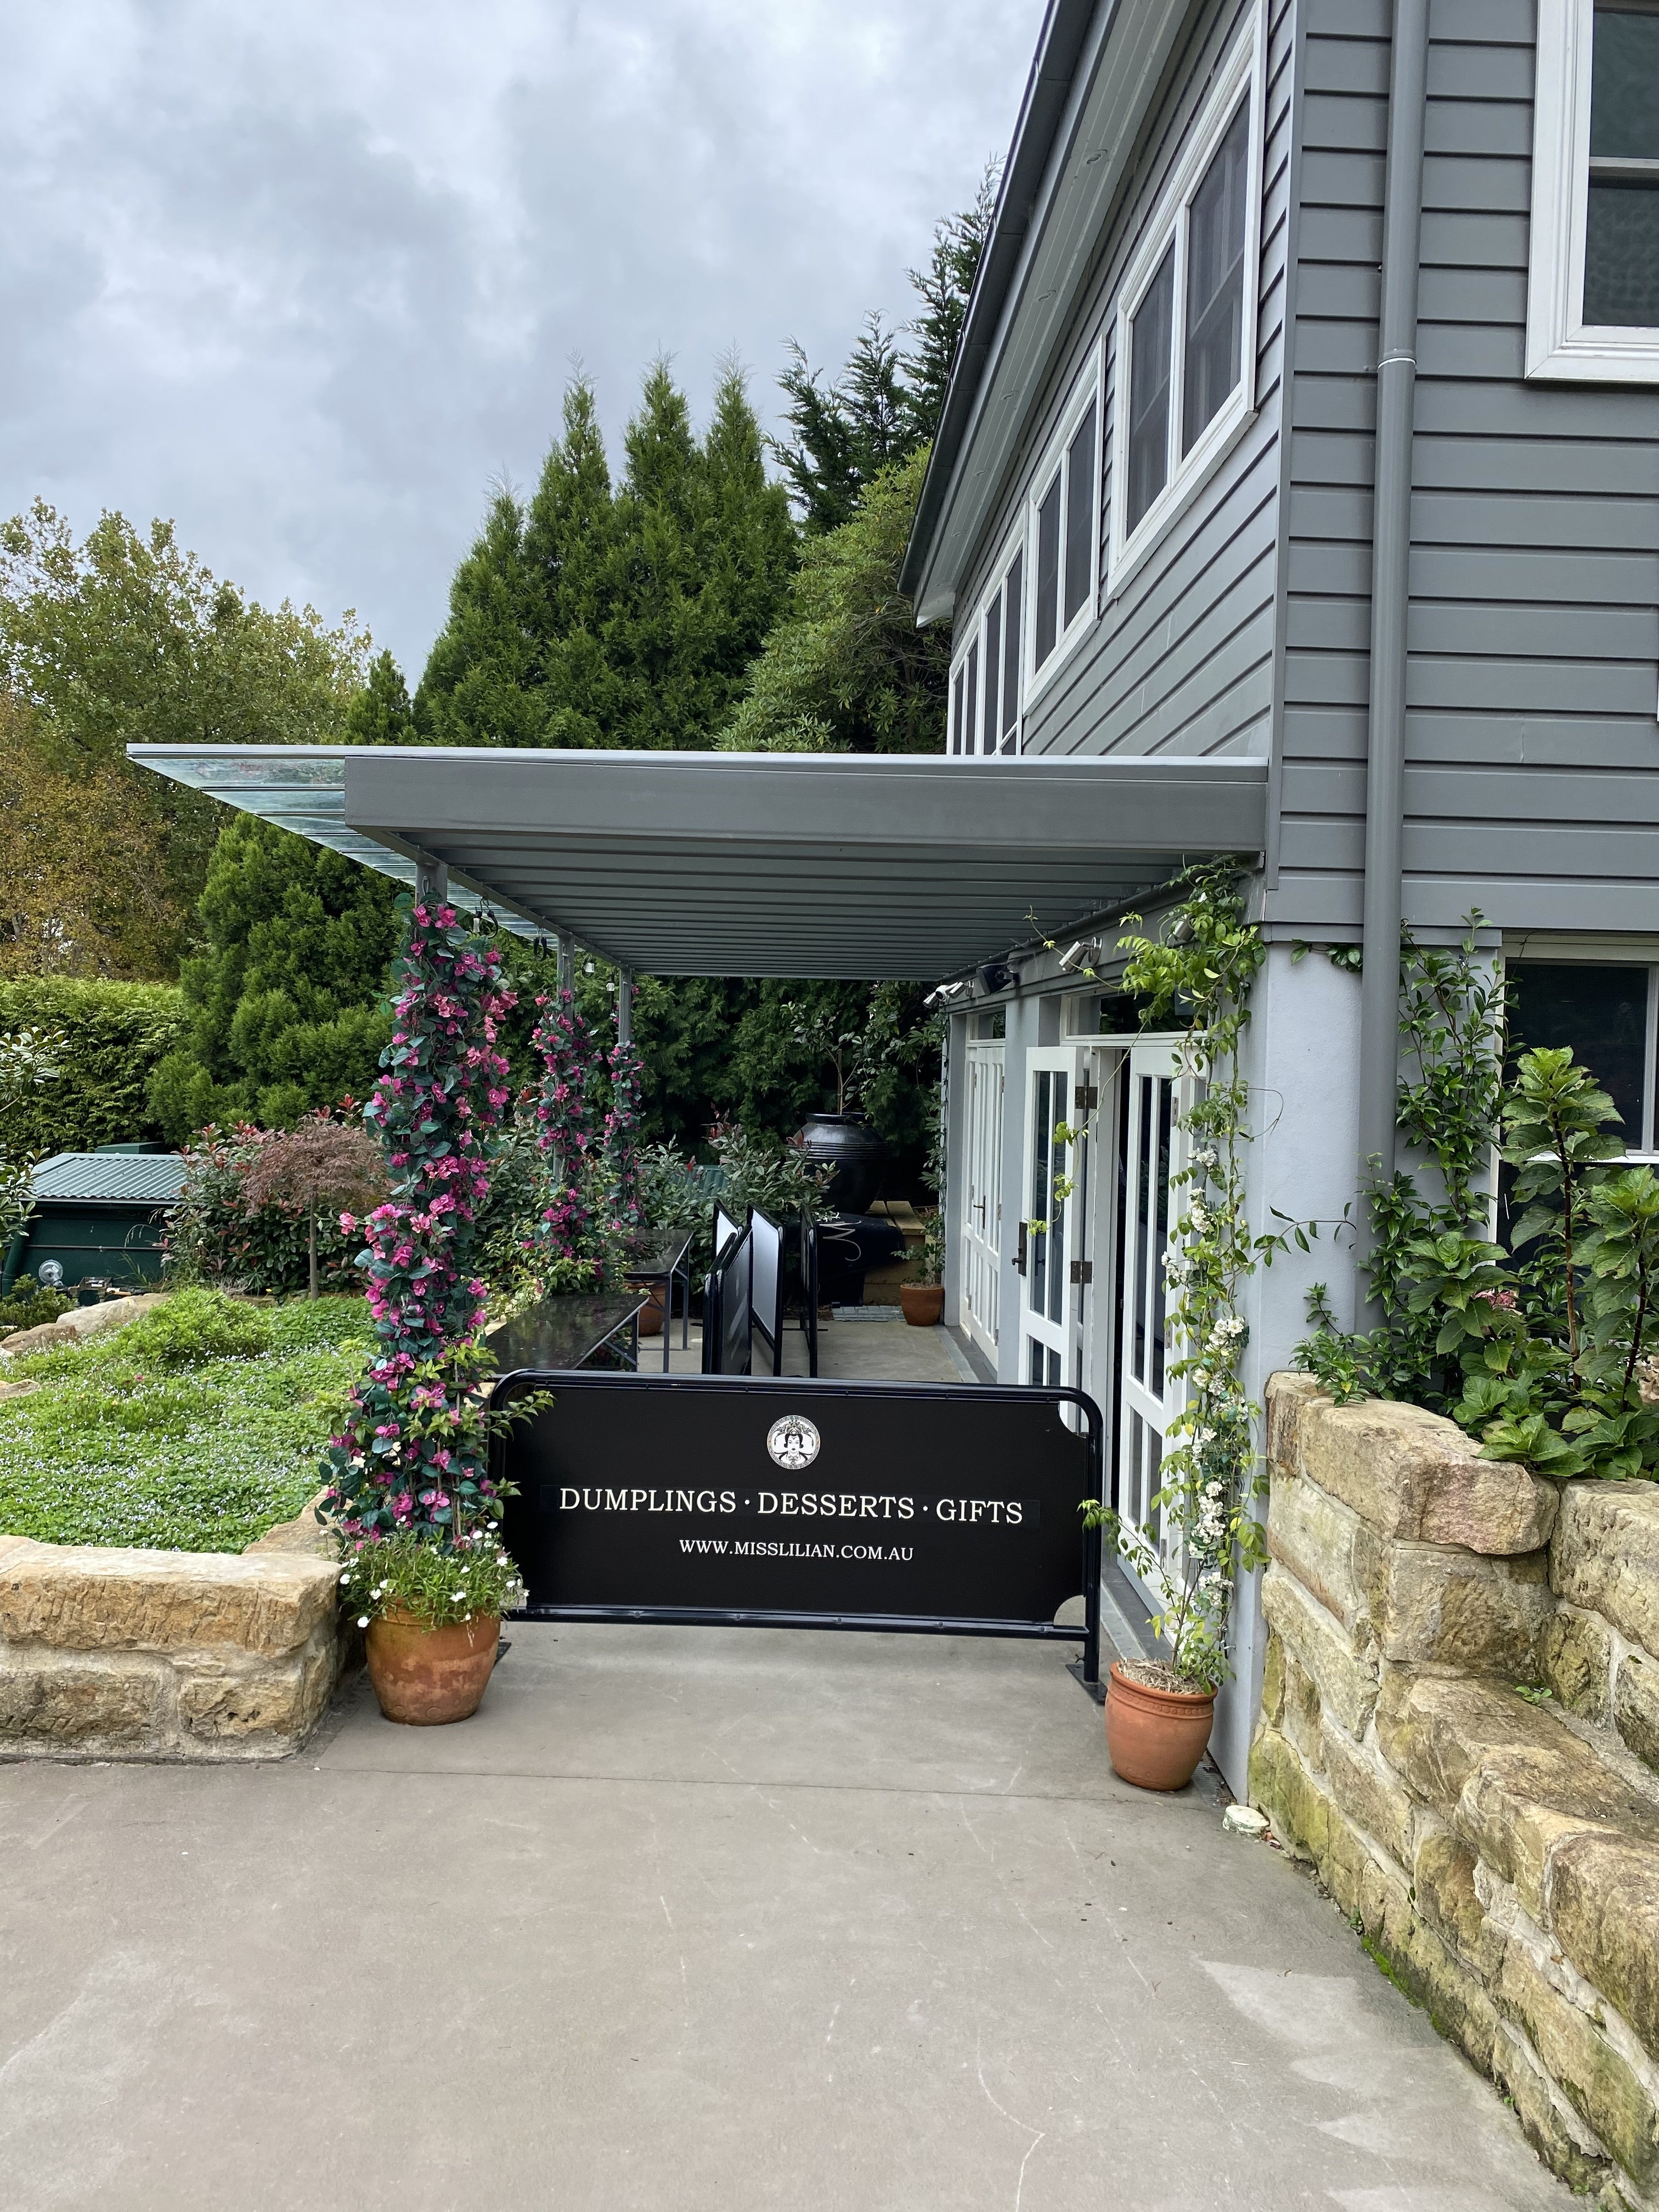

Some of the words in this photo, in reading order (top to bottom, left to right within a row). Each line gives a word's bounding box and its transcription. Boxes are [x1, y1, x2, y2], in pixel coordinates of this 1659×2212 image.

[558, 1487, 737, 1513] DUMPLINGS
[757, 1492, 915, 1519] DESSERTS
[935, 1498, 1023, 1524] GIFTS
[678, 1539, 915, 1561] WWW.MISSLILIAN.COM.AU
